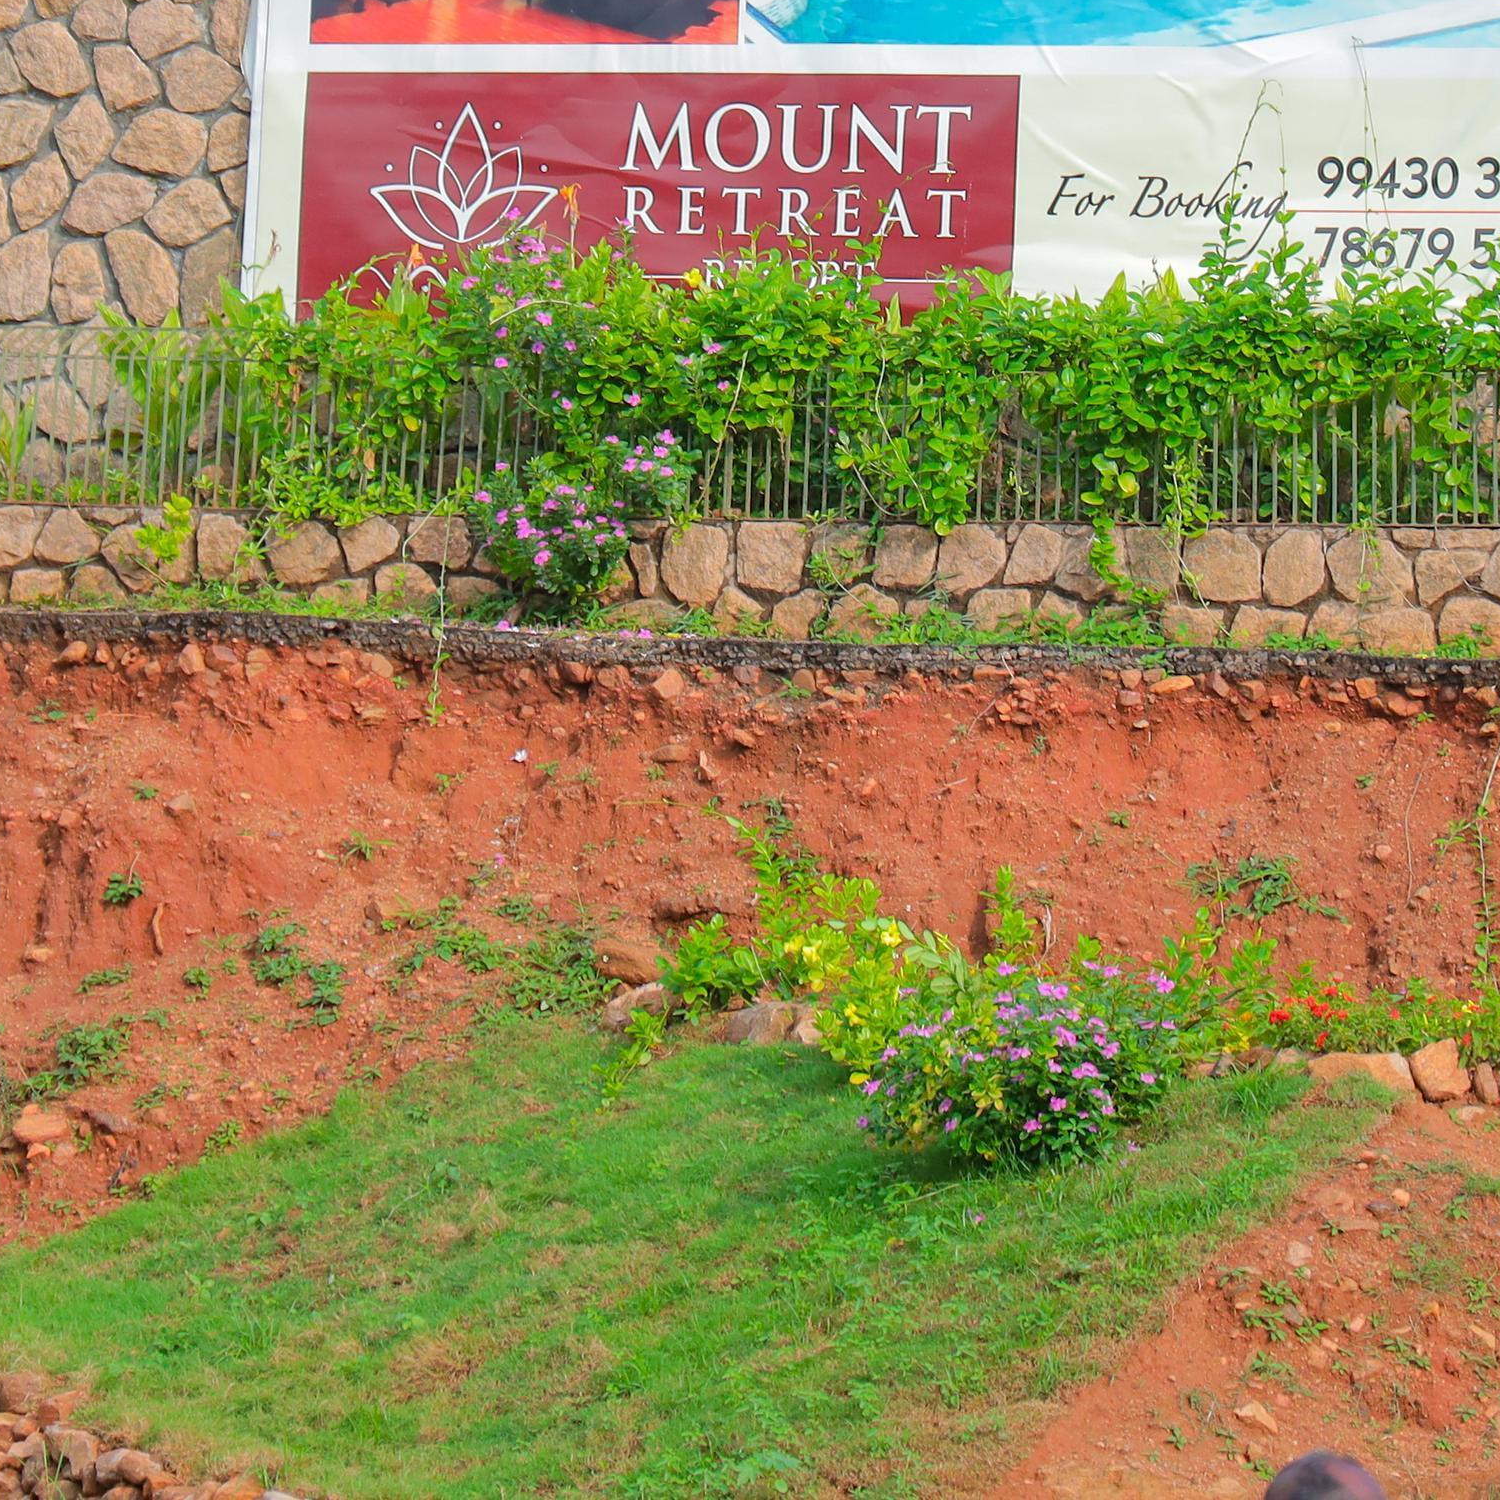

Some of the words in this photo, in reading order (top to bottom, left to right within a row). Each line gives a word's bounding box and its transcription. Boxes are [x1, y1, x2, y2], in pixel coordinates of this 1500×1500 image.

[618, 100, 973, 174] MOUNT
[1316, 155, 1461, 200] 99430
[615, 186, 967, 238] RETREAT
[1046, 172, 1116, 217] For
[1128, 160, 1289, 264] Booking
[1313, 226, 1456, 271] 78679
